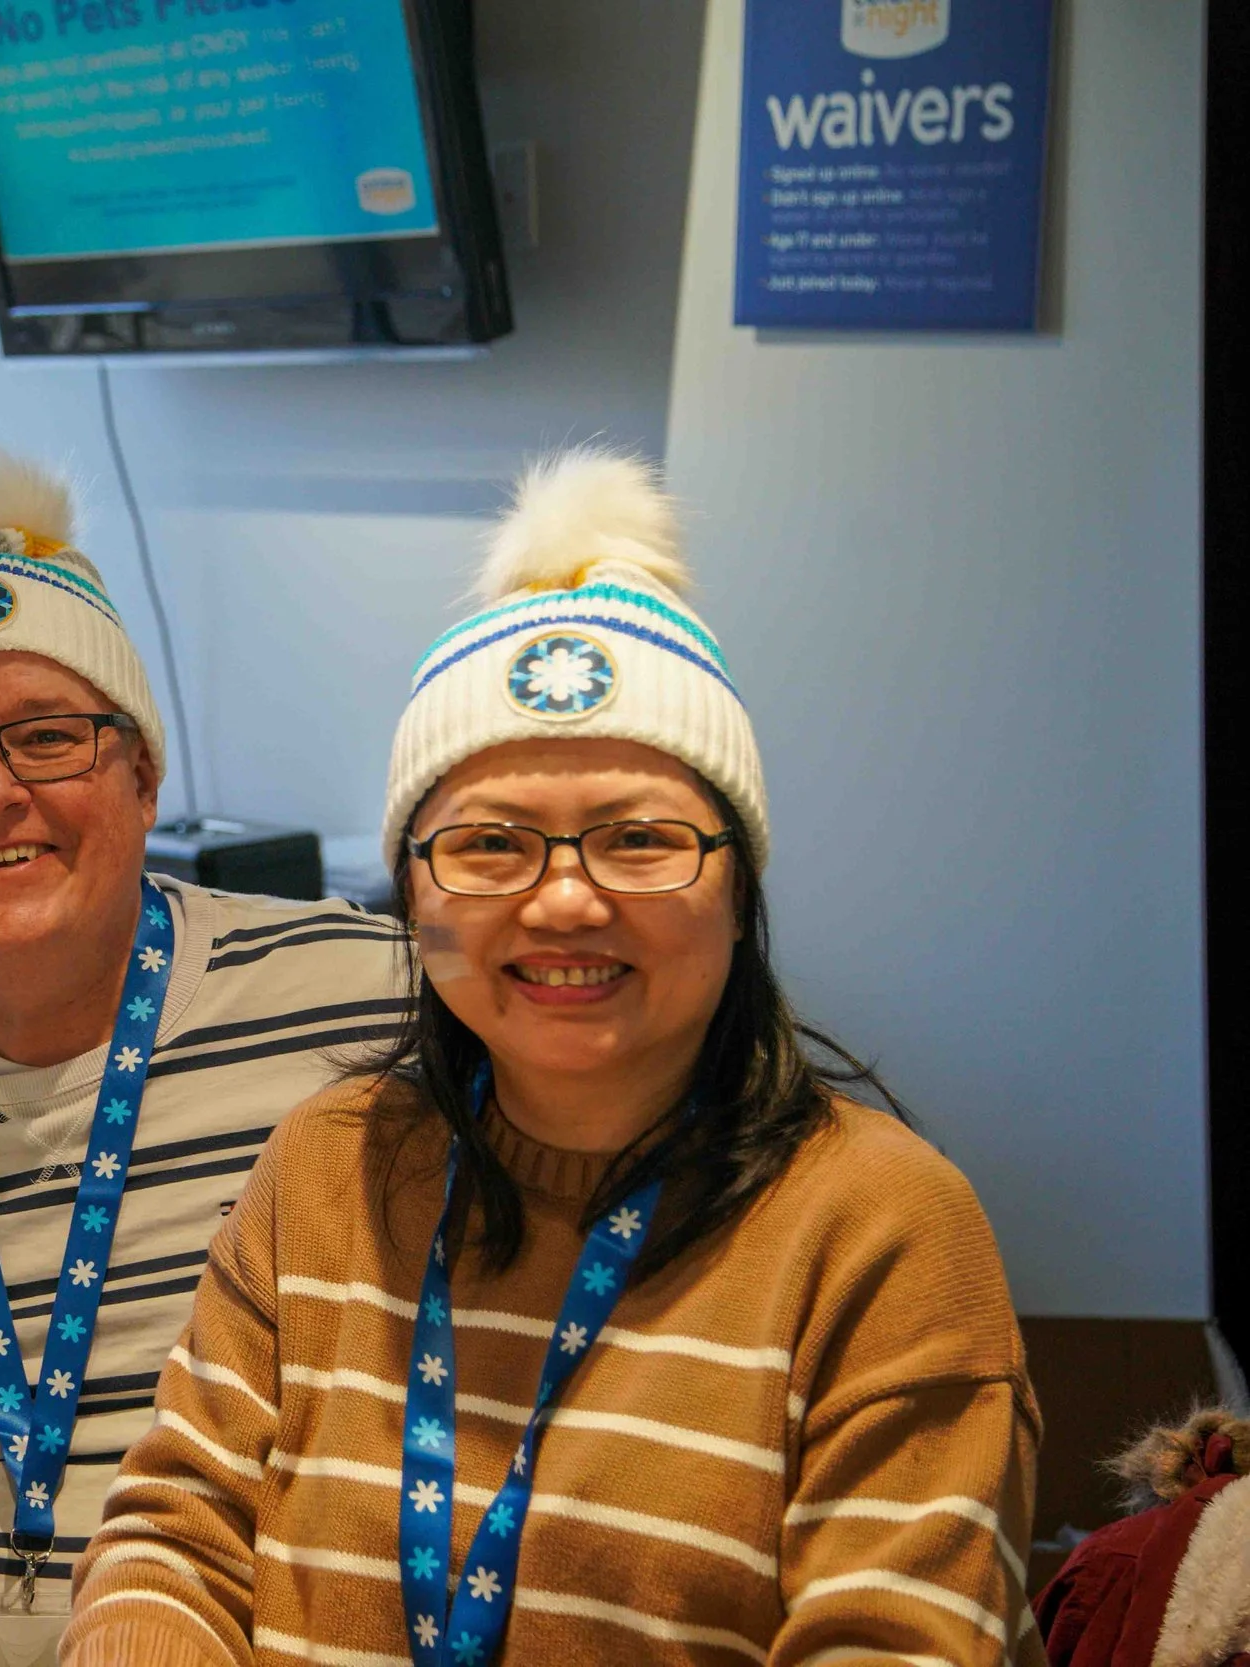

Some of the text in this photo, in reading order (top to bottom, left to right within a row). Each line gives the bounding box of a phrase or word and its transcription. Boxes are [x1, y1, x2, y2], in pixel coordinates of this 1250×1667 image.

[54, 0, 143, 37] Pets
[156, 0, 298, 22] Ple
[766, 67, 1015, 150] waivers
